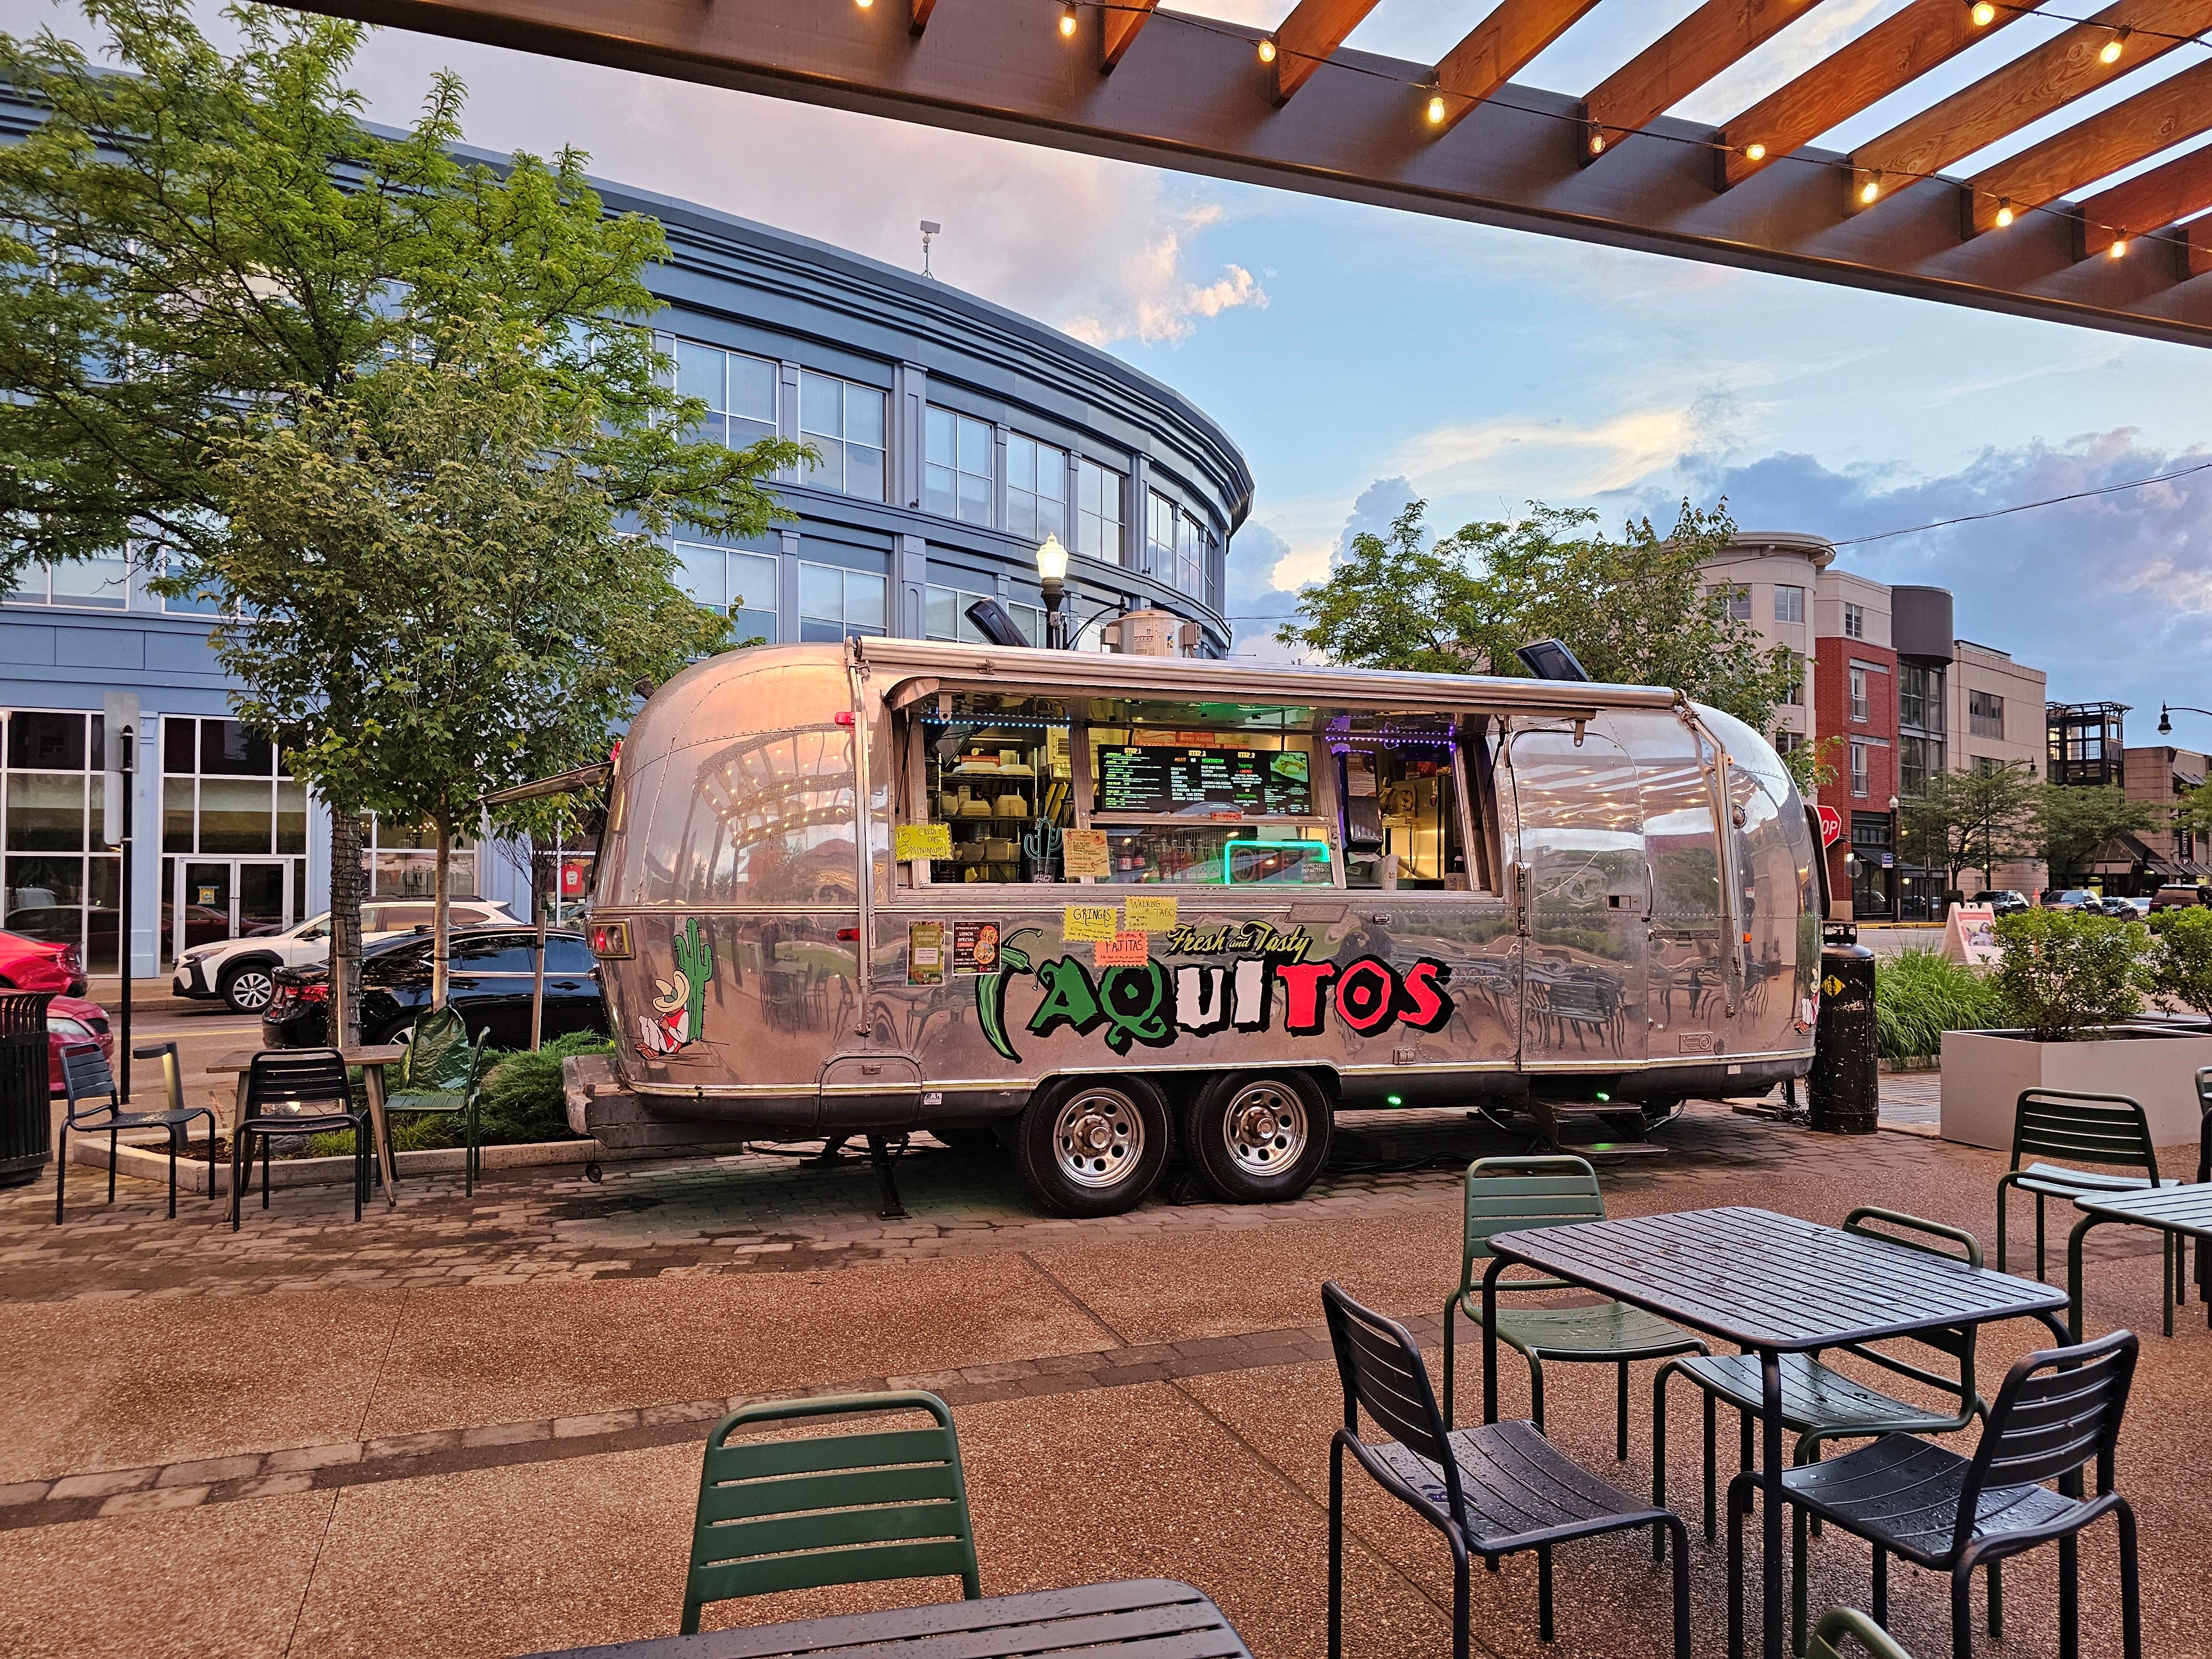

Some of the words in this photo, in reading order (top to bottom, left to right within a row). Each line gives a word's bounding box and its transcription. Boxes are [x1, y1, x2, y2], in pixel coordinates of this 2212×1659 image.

[1822, 820, 1838, 836] OP
[910, 846, 946, 854] MINIMUM!
[1232, 848, 1310, 883] OPE
[1130, 899, 1160, 909] WALKING
[1073, 909, 1111, 927] GRINGAS
[1154, 908, 1175, 917] TACO
[1106, 940, 1143, 953] FAJITAS
[1165, 923, 1231, 956] Fresh
[1228, 936, 1251, 949] and
[1240, 920, 1313, 963] Tasty
